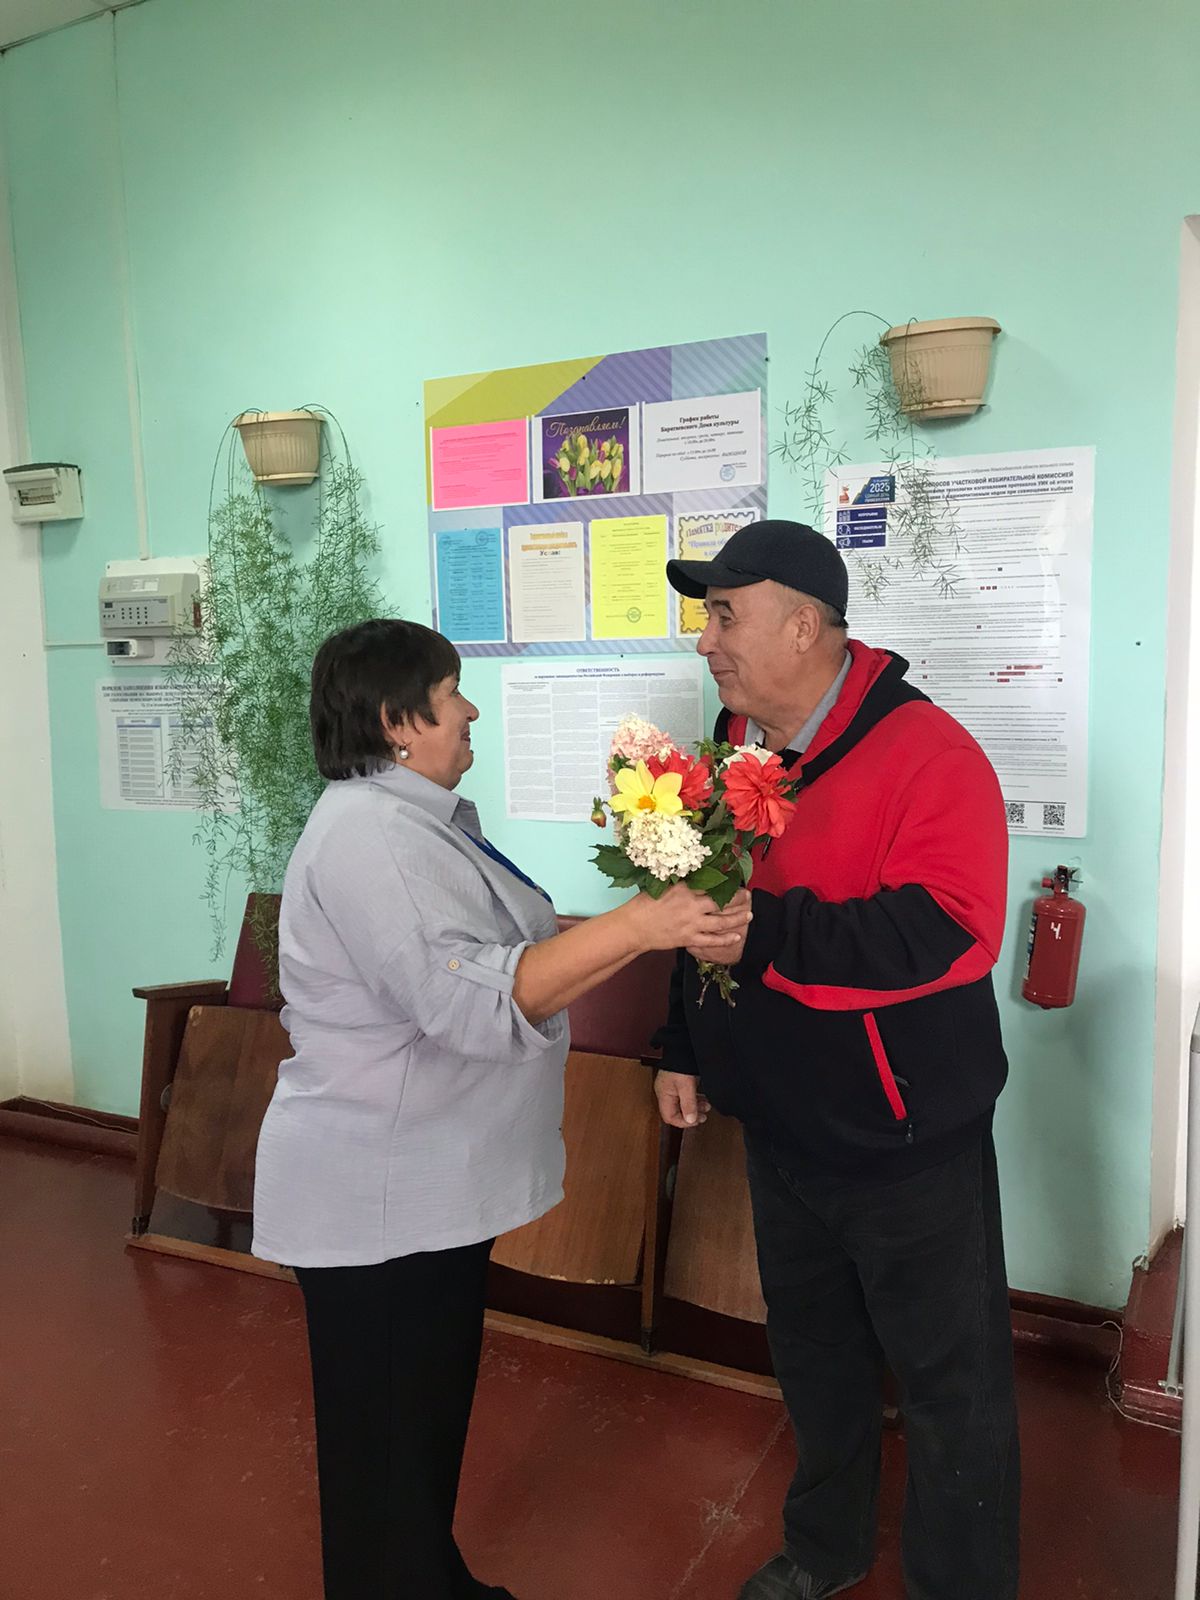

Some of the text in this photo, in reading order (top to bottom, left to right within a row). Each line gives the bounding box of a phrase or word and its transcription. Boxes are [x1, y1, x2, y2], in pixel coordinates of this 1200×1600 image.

[545, 415, 626, 438] Поздравляем!
[951, 476, 987, 486] УЧАСТКОВОЙ
[988, 472, 1036, 483] ИЗБИРАТЕЛЬНОЙ
[1037, 470, 1074, 480] КОМИССИЕЙ
[869, 482, 891, 493] 2025
[686, 521, 743, 537] Памятка родите
